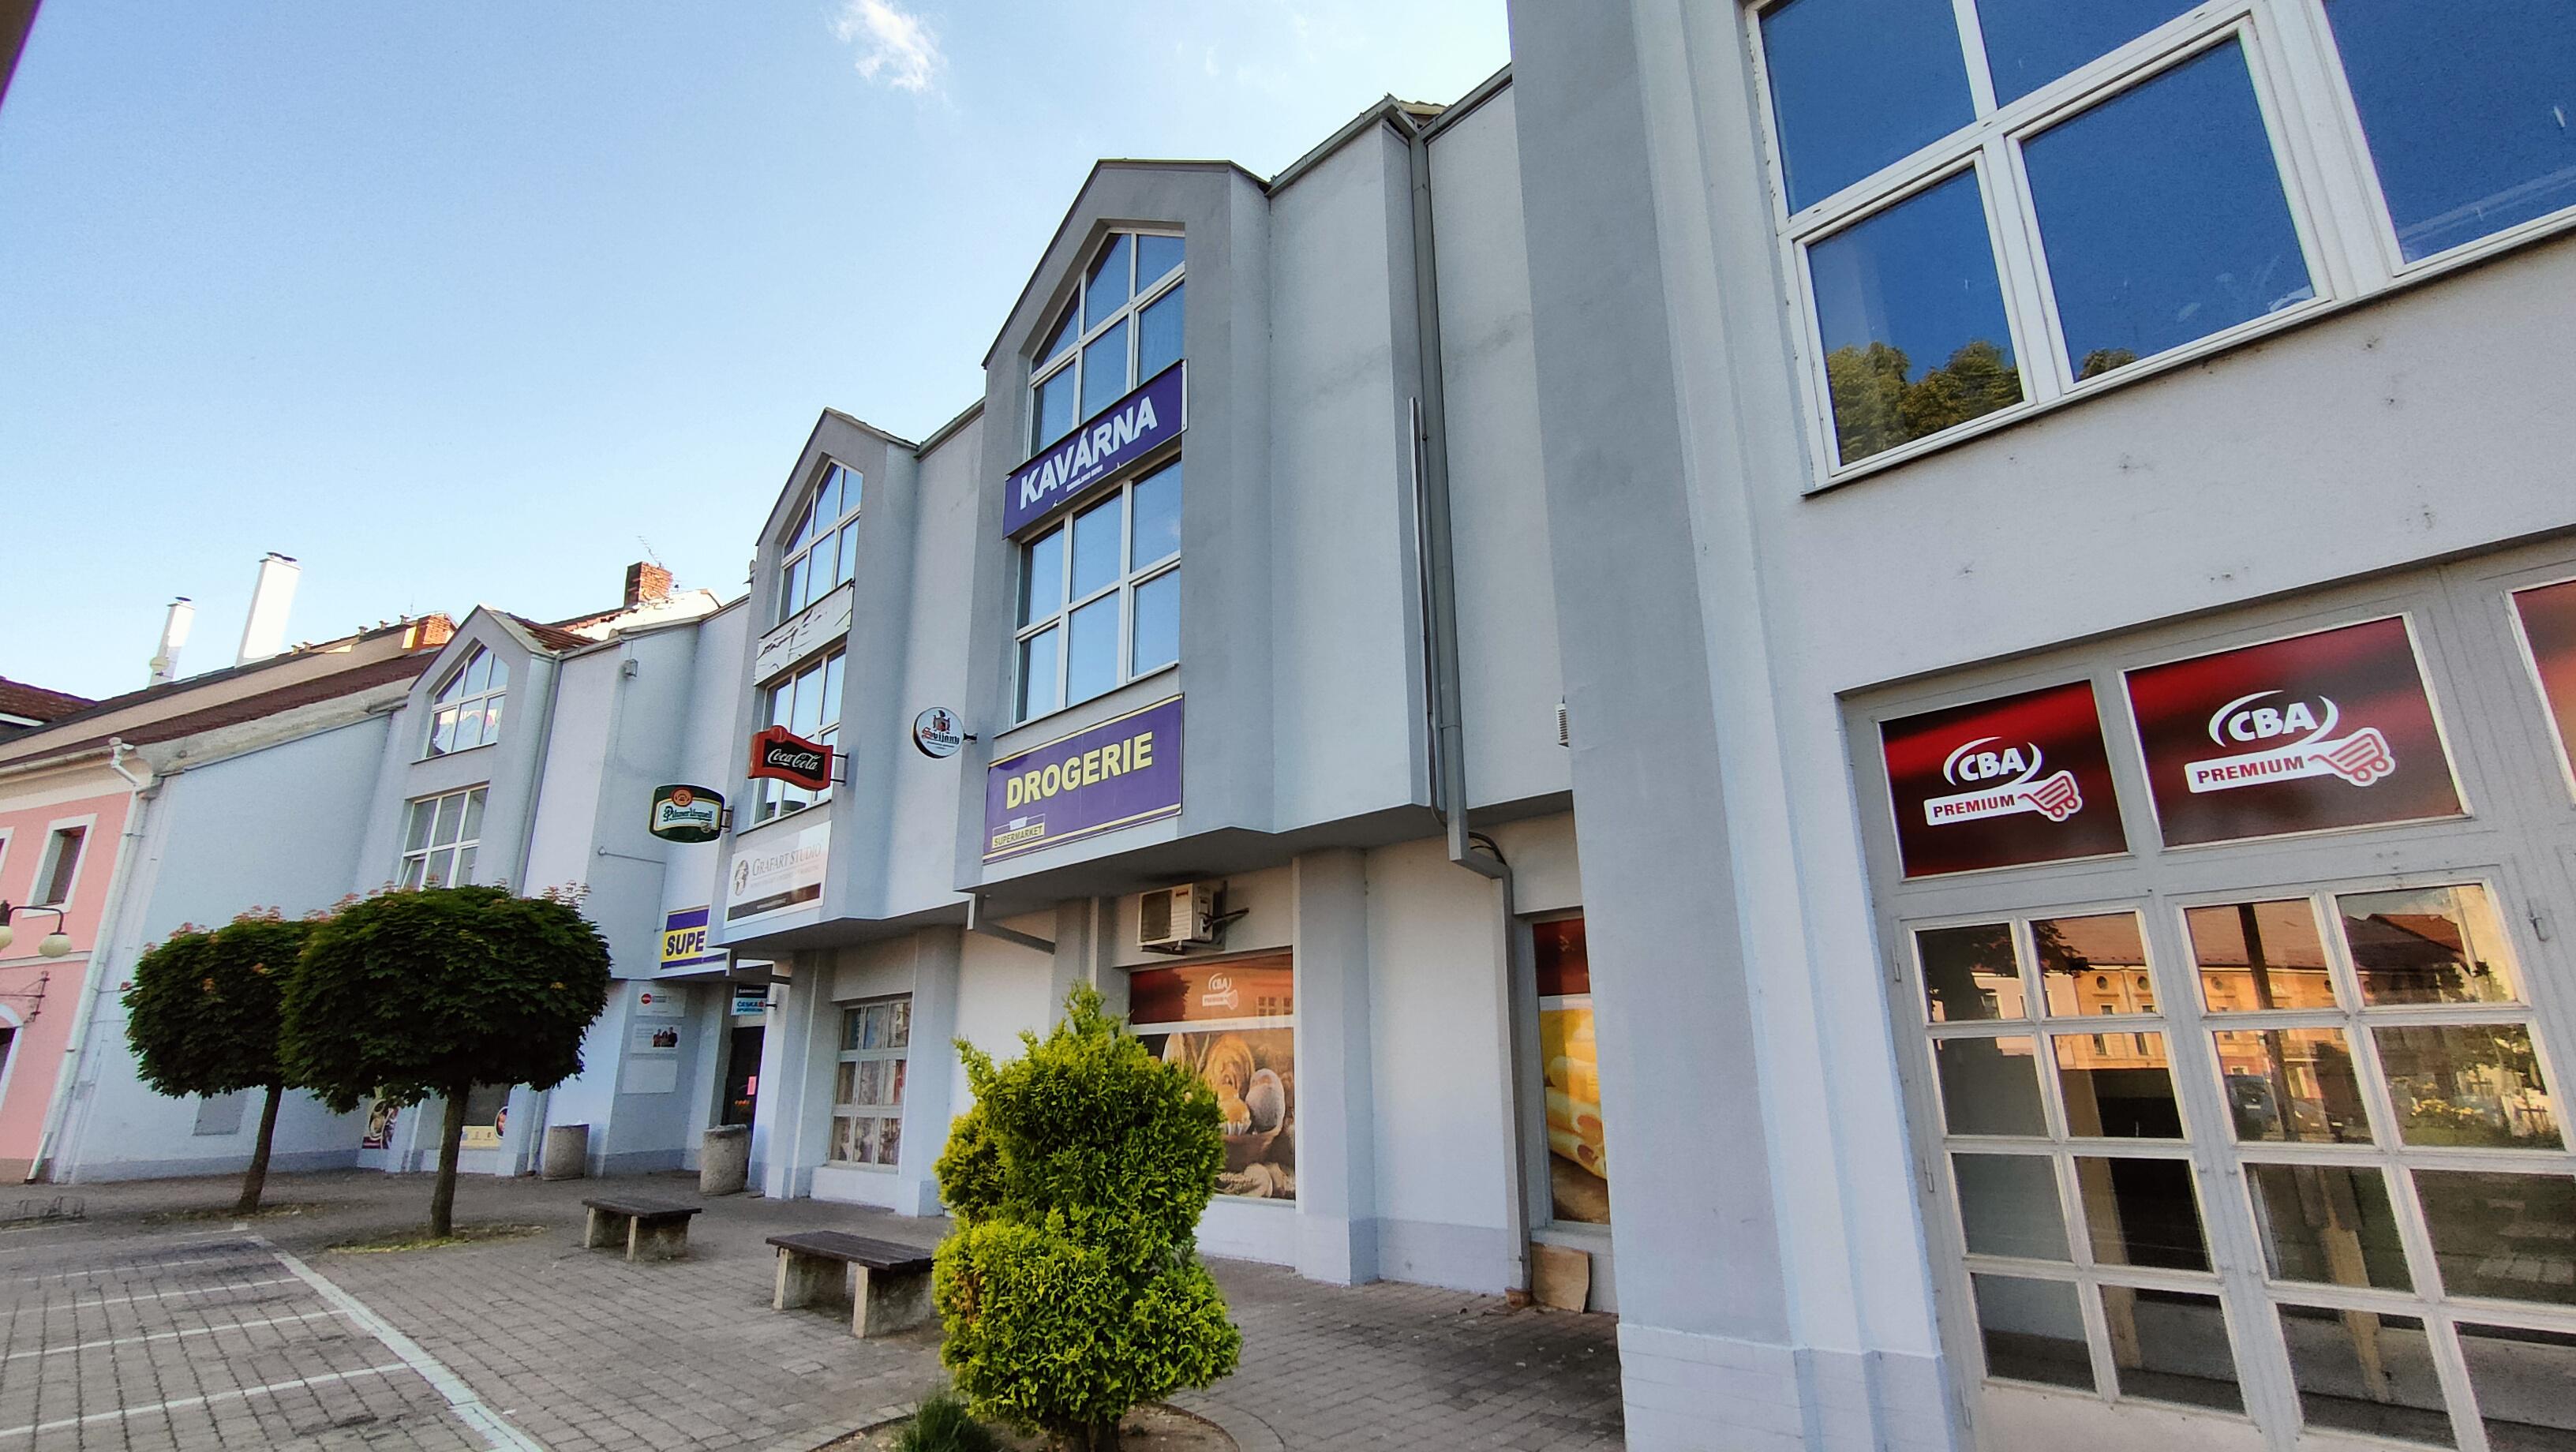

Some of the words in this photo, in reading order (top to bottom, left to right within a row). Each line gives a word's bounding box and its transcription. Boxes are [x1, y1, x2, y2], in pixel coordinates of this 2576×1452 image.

[1020, 395, 1158, 511] KAVÁRNA
[2228, 702, 2319, 742] CBA
[1006, 731, 1153, 810] DROGERIE
[1958, 747, 2027, 781] CBA
[2196, 755, 2305, 784] PREMIUM
[1933, 794, 2016, 818] PREMIUM
[994, 825, 1043, 847] SUPERMARKET
[790, 843, 822, 865] STUDIO
[665, 930, 706, 956] SUPE
